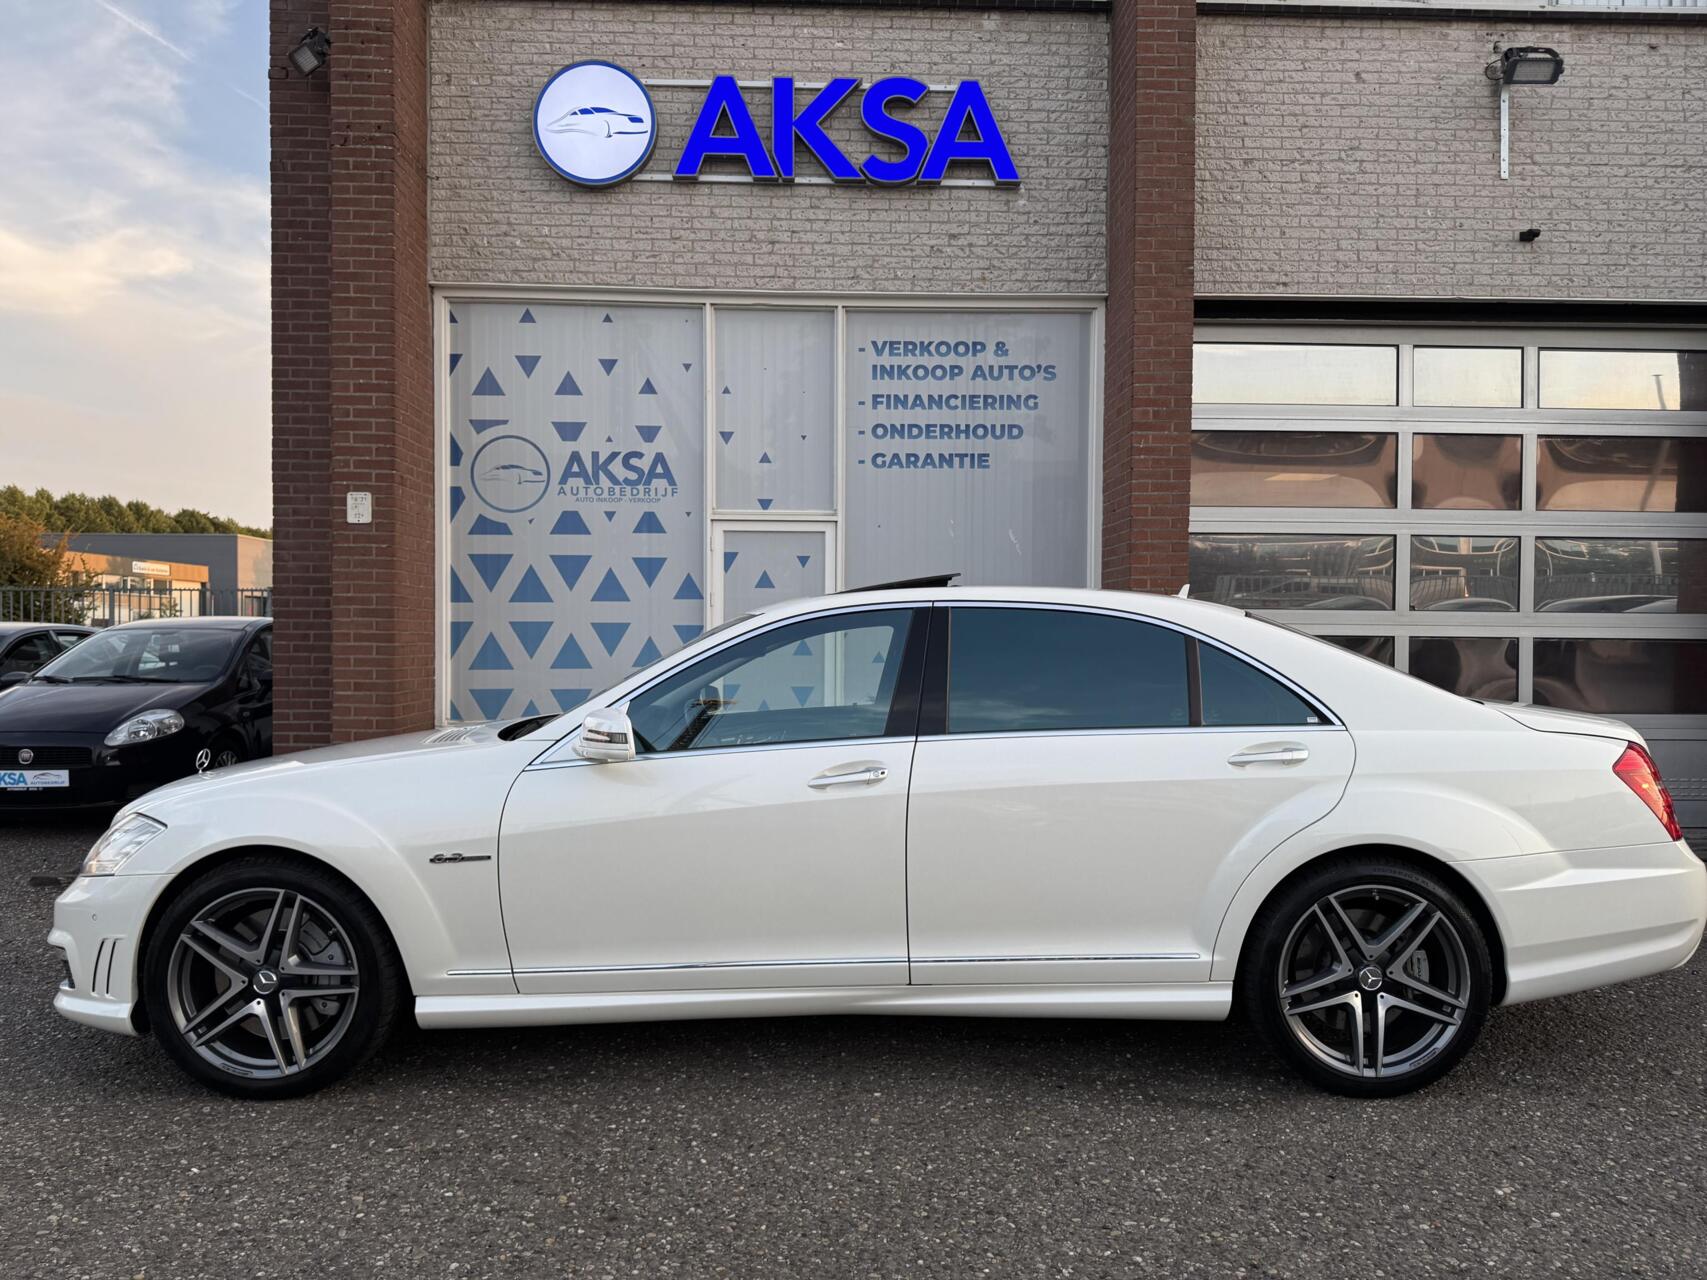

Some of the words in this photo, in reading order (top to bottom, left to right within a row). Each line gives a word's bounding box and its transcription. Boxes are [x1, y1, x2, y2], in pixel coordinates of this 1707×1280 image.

[673, 74, 1022, 186] AKSA
[871, 341, 987, 358] VERKOOP
[993, 341, 1009, 357] &
[871, 364, 964, 381] INKOOP
[970, 365, 1057, 382] AUTO’S
[871, 394, 1039, 411] FINANCIERING
[871, 423, 1024, 440] ONDERHOUD
[558, 450, 678, 487] AKSA
[871, 453, 991, 469] GARANTIE
[557, 486, 679, 498] AUTOBEDRIJF
[0, 772, 28, 786] KSA
